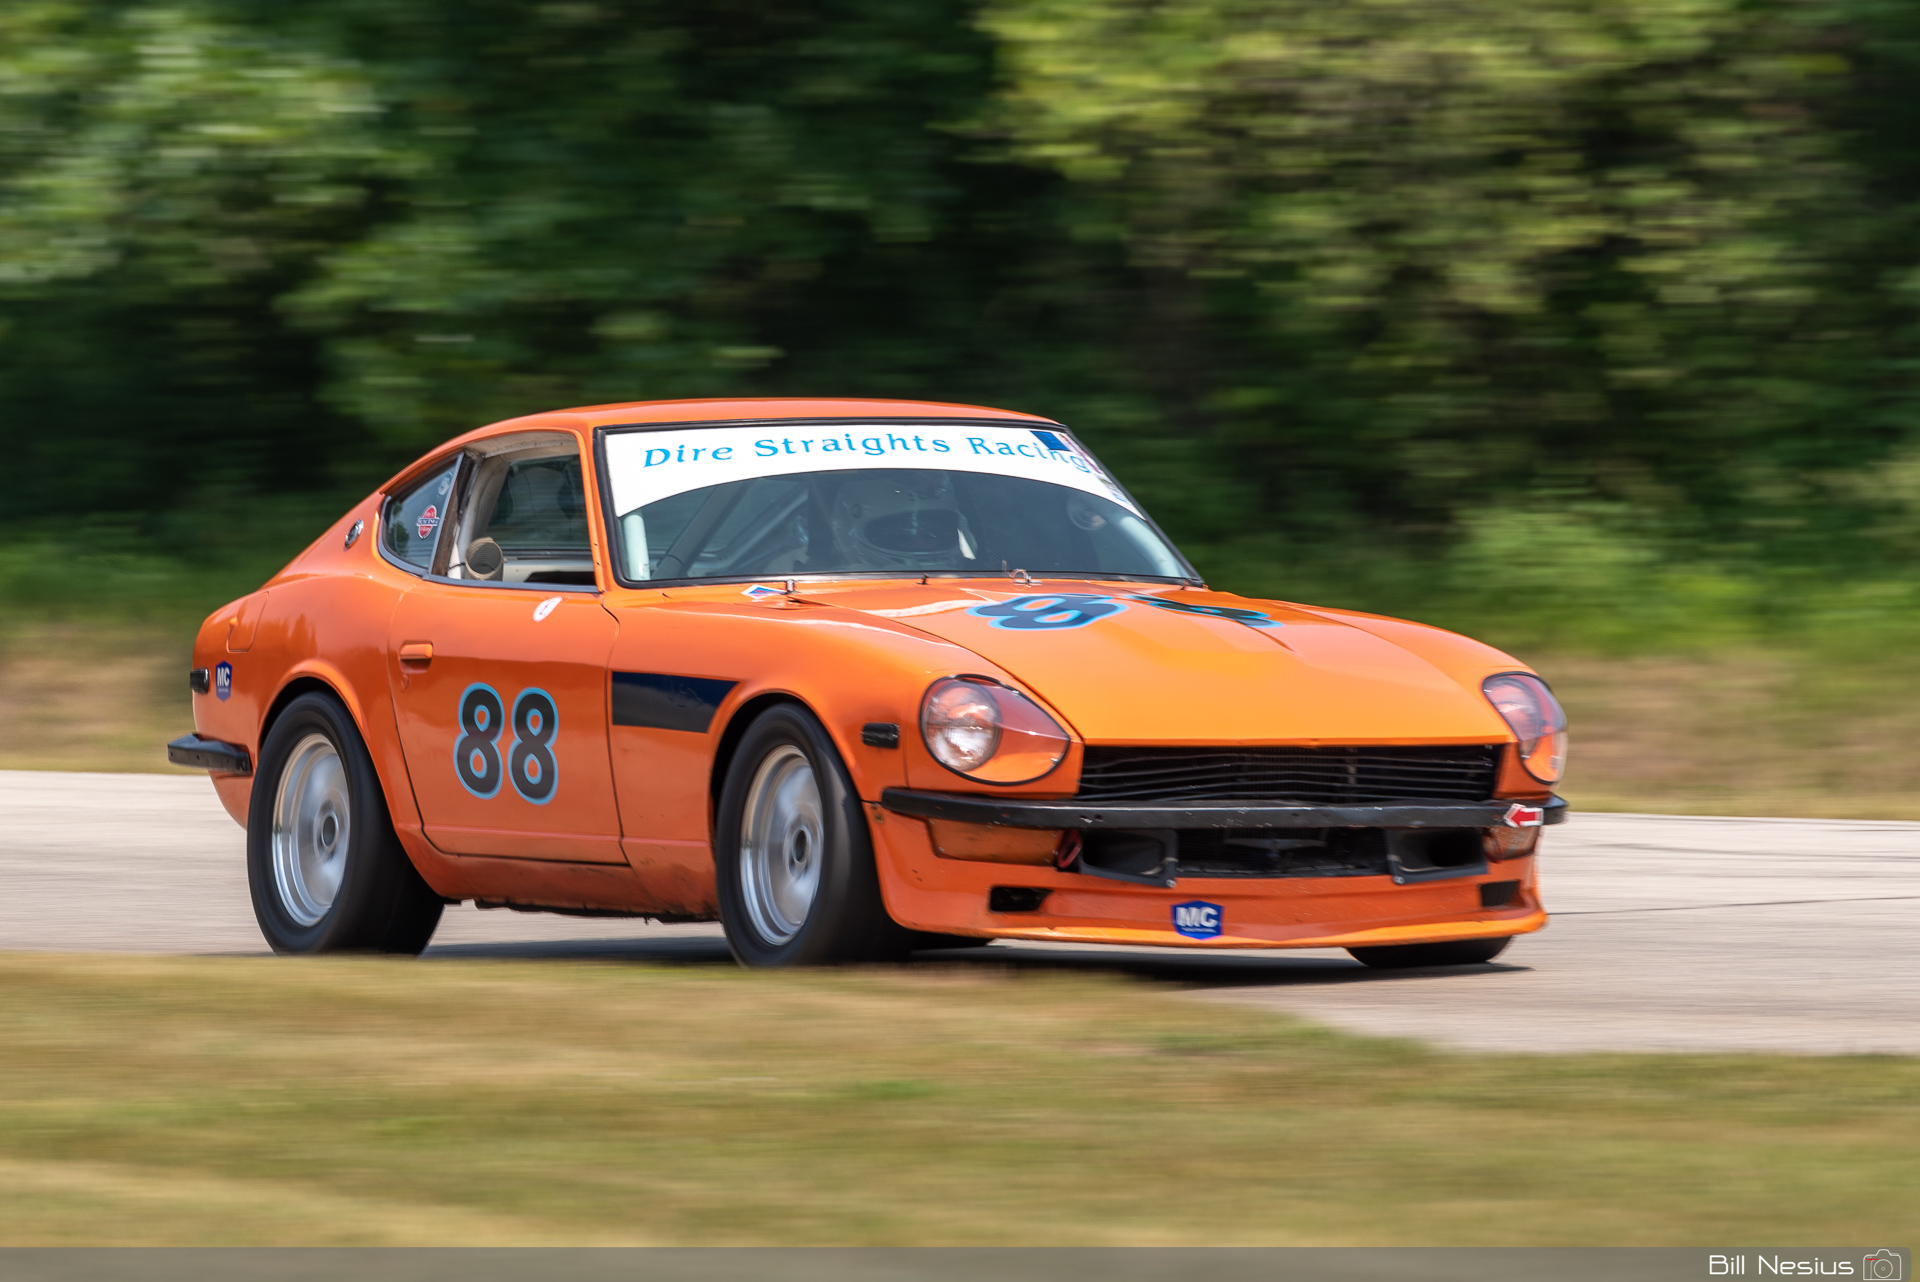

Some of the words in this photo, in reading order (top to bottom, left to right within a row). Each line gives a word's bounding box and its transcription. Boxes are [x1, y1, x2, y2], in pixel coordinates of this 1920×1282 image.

[643, 444, 733, 468] Dire
[754, 433, 951, 456] Straights
[970, 436, 1091, 474] Racing
[217, 667, 230, 687] MC
[454, 682, 559, 805] 88
[1176, 906, 1218, 927] MC
